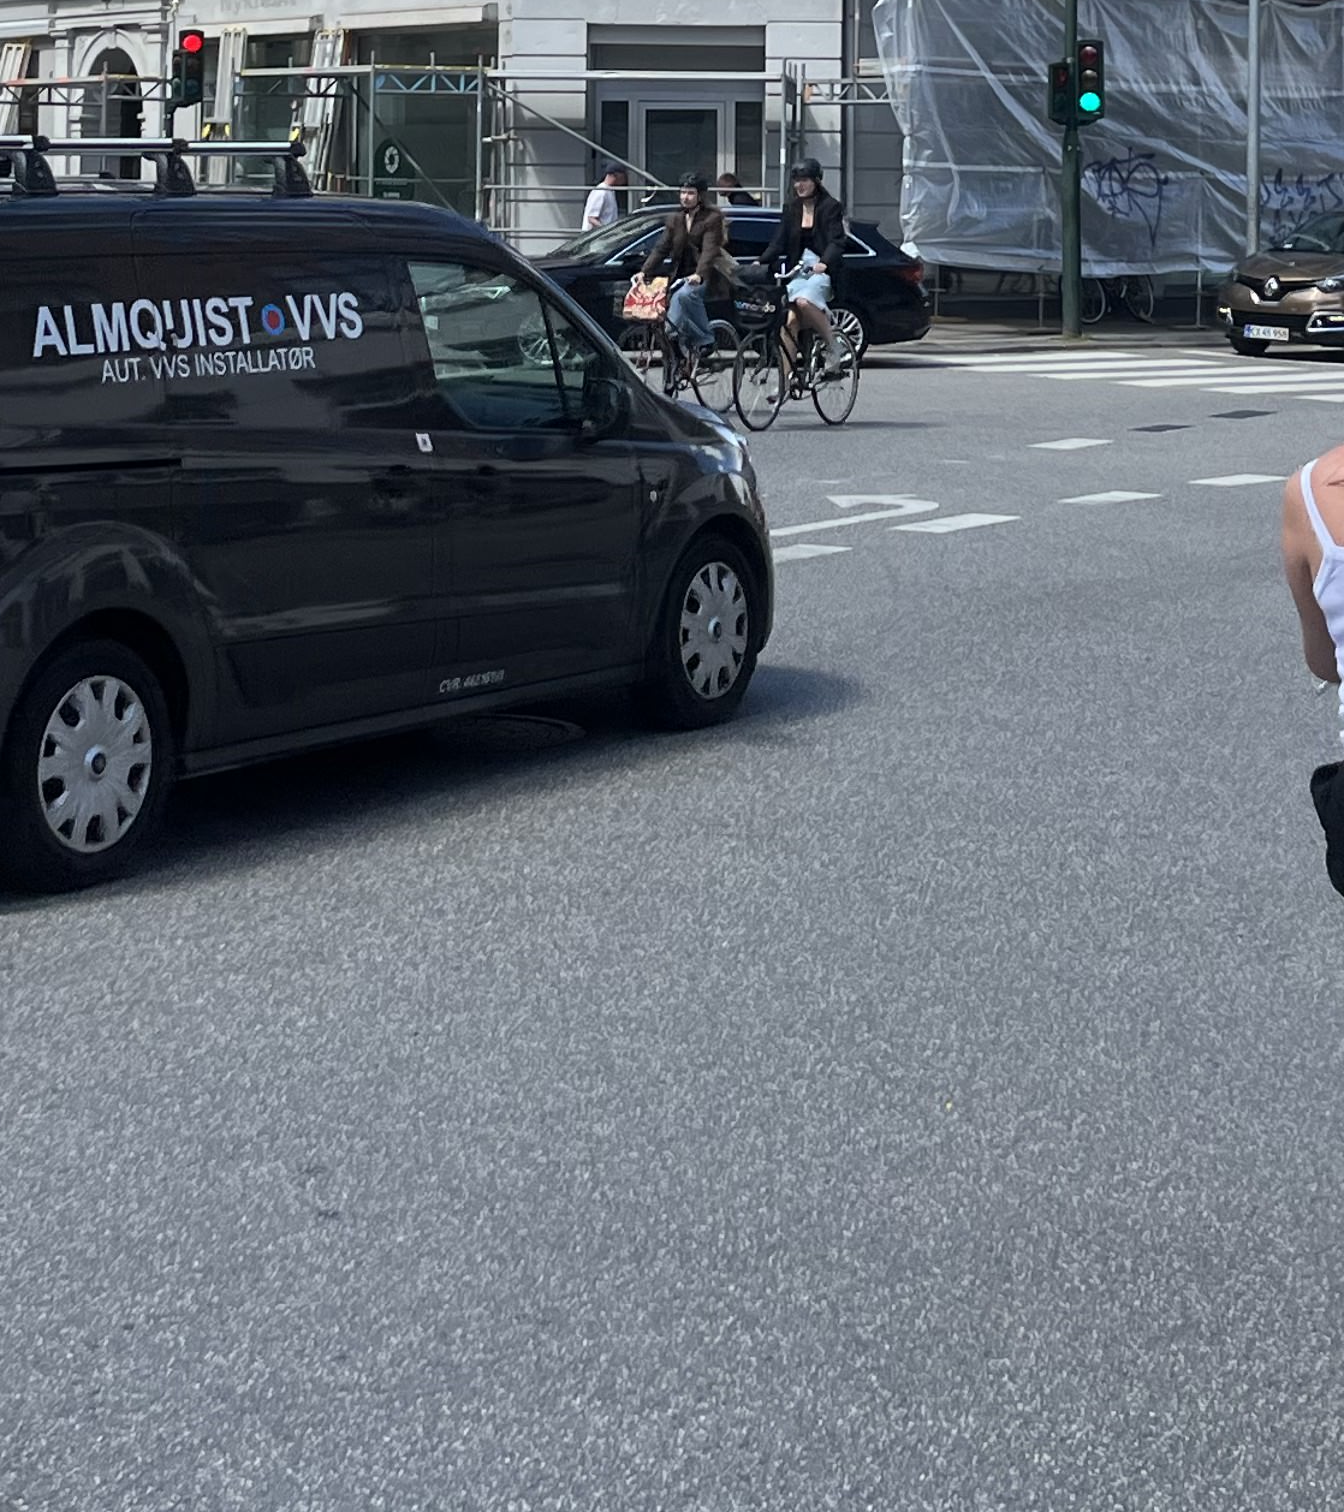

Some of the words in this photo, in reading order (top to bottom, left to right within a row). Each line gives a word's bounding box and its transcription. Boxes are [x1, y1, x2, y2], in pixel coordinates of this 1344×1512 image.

[32, 294, 254, 358] ALMQUIST
[284, 291, 364, 342] VVS
[100, 357, 147, 385] AUT.
[151, 353, 190, 381] VVS
[194, 346, 317, 377] INSTALLATØR
